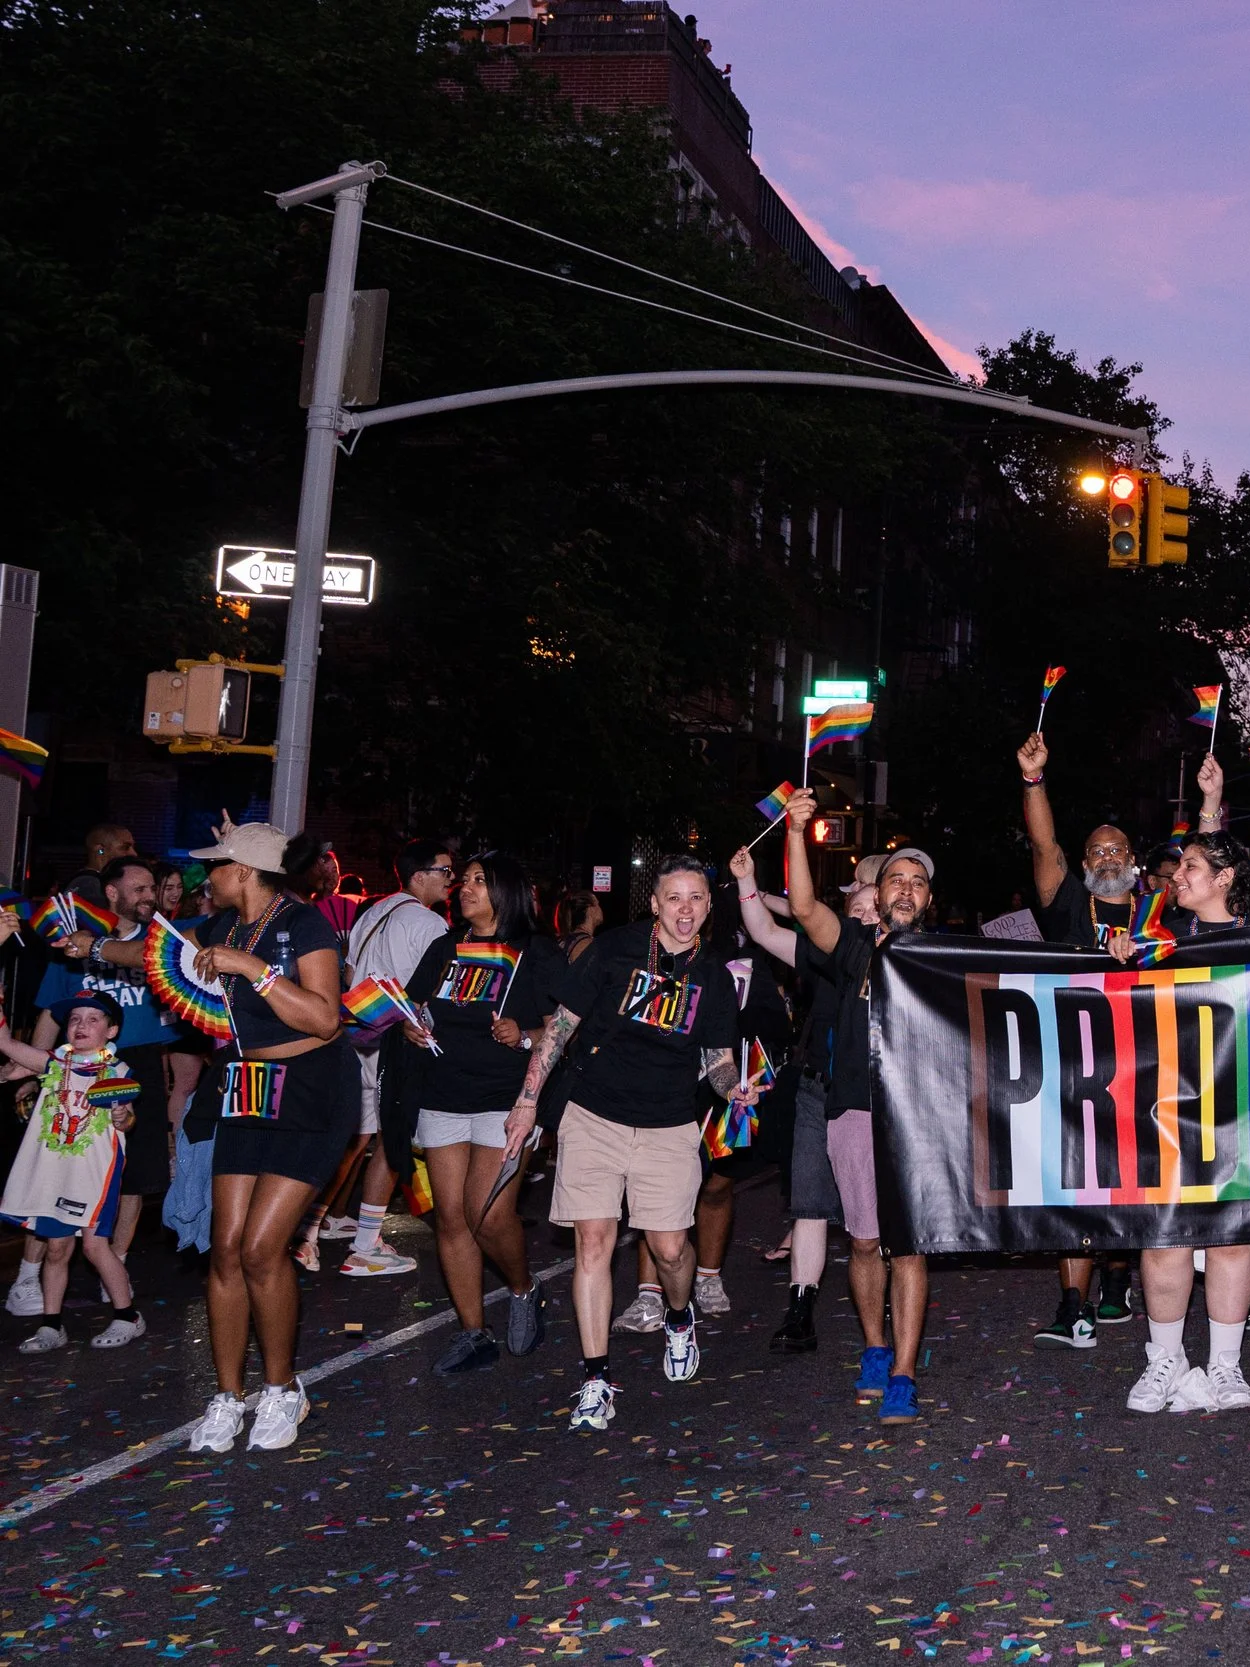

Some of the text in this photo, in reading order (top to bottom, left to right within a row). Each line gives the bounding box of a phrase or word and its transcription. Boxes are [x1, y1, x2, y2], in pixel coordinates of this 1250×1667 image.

[250, 564, 351, 587] ONE AY
[985, 916, 1016, 937] GOOD
[88, 1087, 140, 1099] LOVE WINS
[222, 1062, 287, 1119] PRIDE
